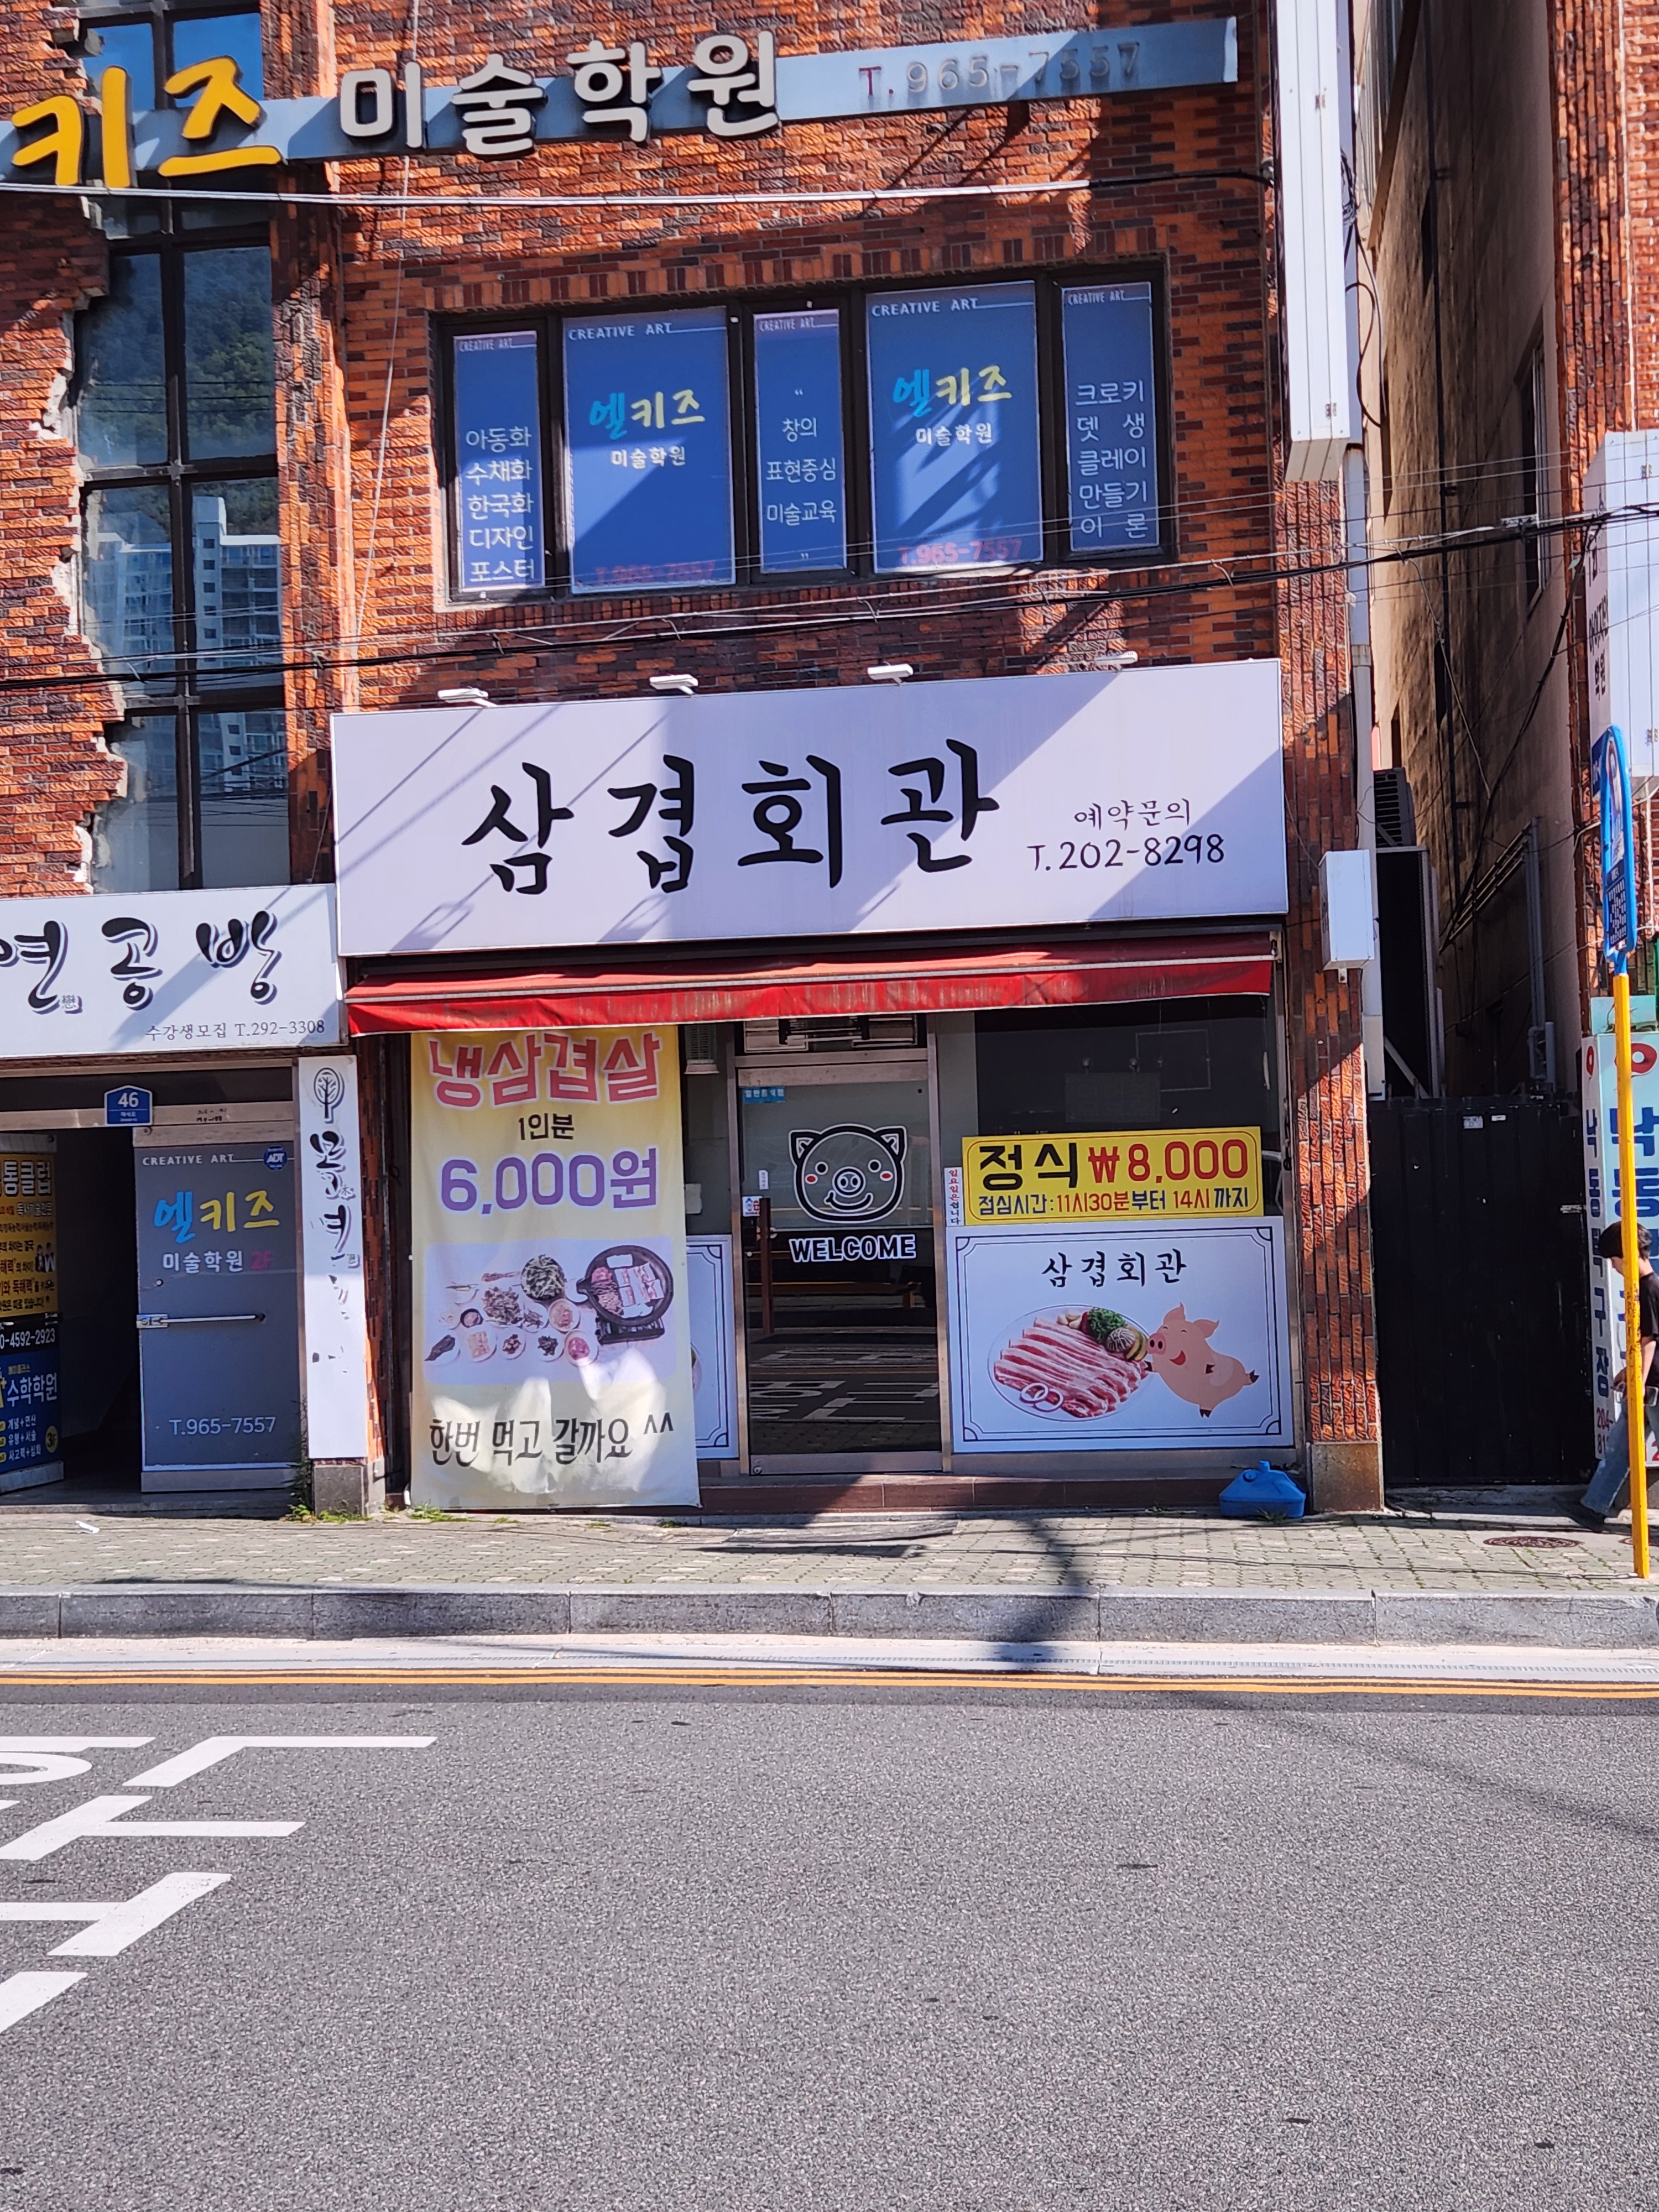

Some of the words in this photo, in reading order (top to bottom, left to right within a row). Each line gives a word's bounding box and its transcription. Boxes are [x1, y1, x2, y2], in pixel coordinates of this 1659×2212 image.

[12, 56, 282, 189] 키즈
[341, 31, 777, 156] 미술학원
[858, 41, 1140, 97] T.965-7557
[872, 301, 940, 317] CREATIVE
[951, 298, 978, 311] ART
[1068, 291, 1105, 305] CREATIVE
[1109, 290, 1125, 301] ART
[568, 325, 635, 341] CREATIVE
[645, 322, 672, 335] ART
[760, 319, 795, 332] CREATIVE
[800, 317, 815, 328] ART
[459, 339, 495, 352] CREATIVE
[498, 338, 513, 349] ART
[1075, 379, 1144, 406] 크로키
[466, 426, 533, 453] 아동화
[781, 418, 818, 442] 창의
[916, 422, 993, 447] 미술학원
[610, 445, 686, 469] 미술학원
[766, 457, 836, 483] 표현중심
[1077, 446, 1146, 476] 클레이
[466, 458, 534, 486] 수채화
[467, 492, 535, 520] 한국화
[1079, 480, 1148, 510] 만들기
[766, 500, 837, 526] 미술교육
[469, 525, 534, 551] 디자인
[899, 538, 1022, 565] T.965-7557
[469, 558, 535, 583] 포스터
[461, 739, 1000, 895] 삼겹회관
[1074, 797, 1191, 831] 예약문의
[1026, 834, 1225, 872] T.202-8298
[145, 1022, 228, 1042] 수강생모집
[234, 1019, 325, 1039] T.292-3308
[429, 1032, 661, 1108] 냉삼겹살
[118, 1092, 139, 1108] 46
[518, 1113, 575, 1140] 1인분
[142, 1155, 202, 1166] CREATIVE
[211, 1154, 234, 1163] ART
[979, 1142, 1078, 1191] 정식
[441, 1147, 658, 1215] 6,000원
[153, 1190, 280, 1244] 엘키즈
[789, 1234, 917, 1262] WELCOME
[163, 1250, 243, 1274] 미술학원
[251, 1250, 273, 1269] 2F
[1041, 1248, 1187, 1288] 삼겹회관
[7, 1372, 58, 1407] 수학학원
[169, 1416, 276, 1437] T.965-7557
[430, 1418, 481, 1467] 한번
[492, 1420, 543, 1467] 먹고
[553, 1418, 633, 1465] 갈까요
